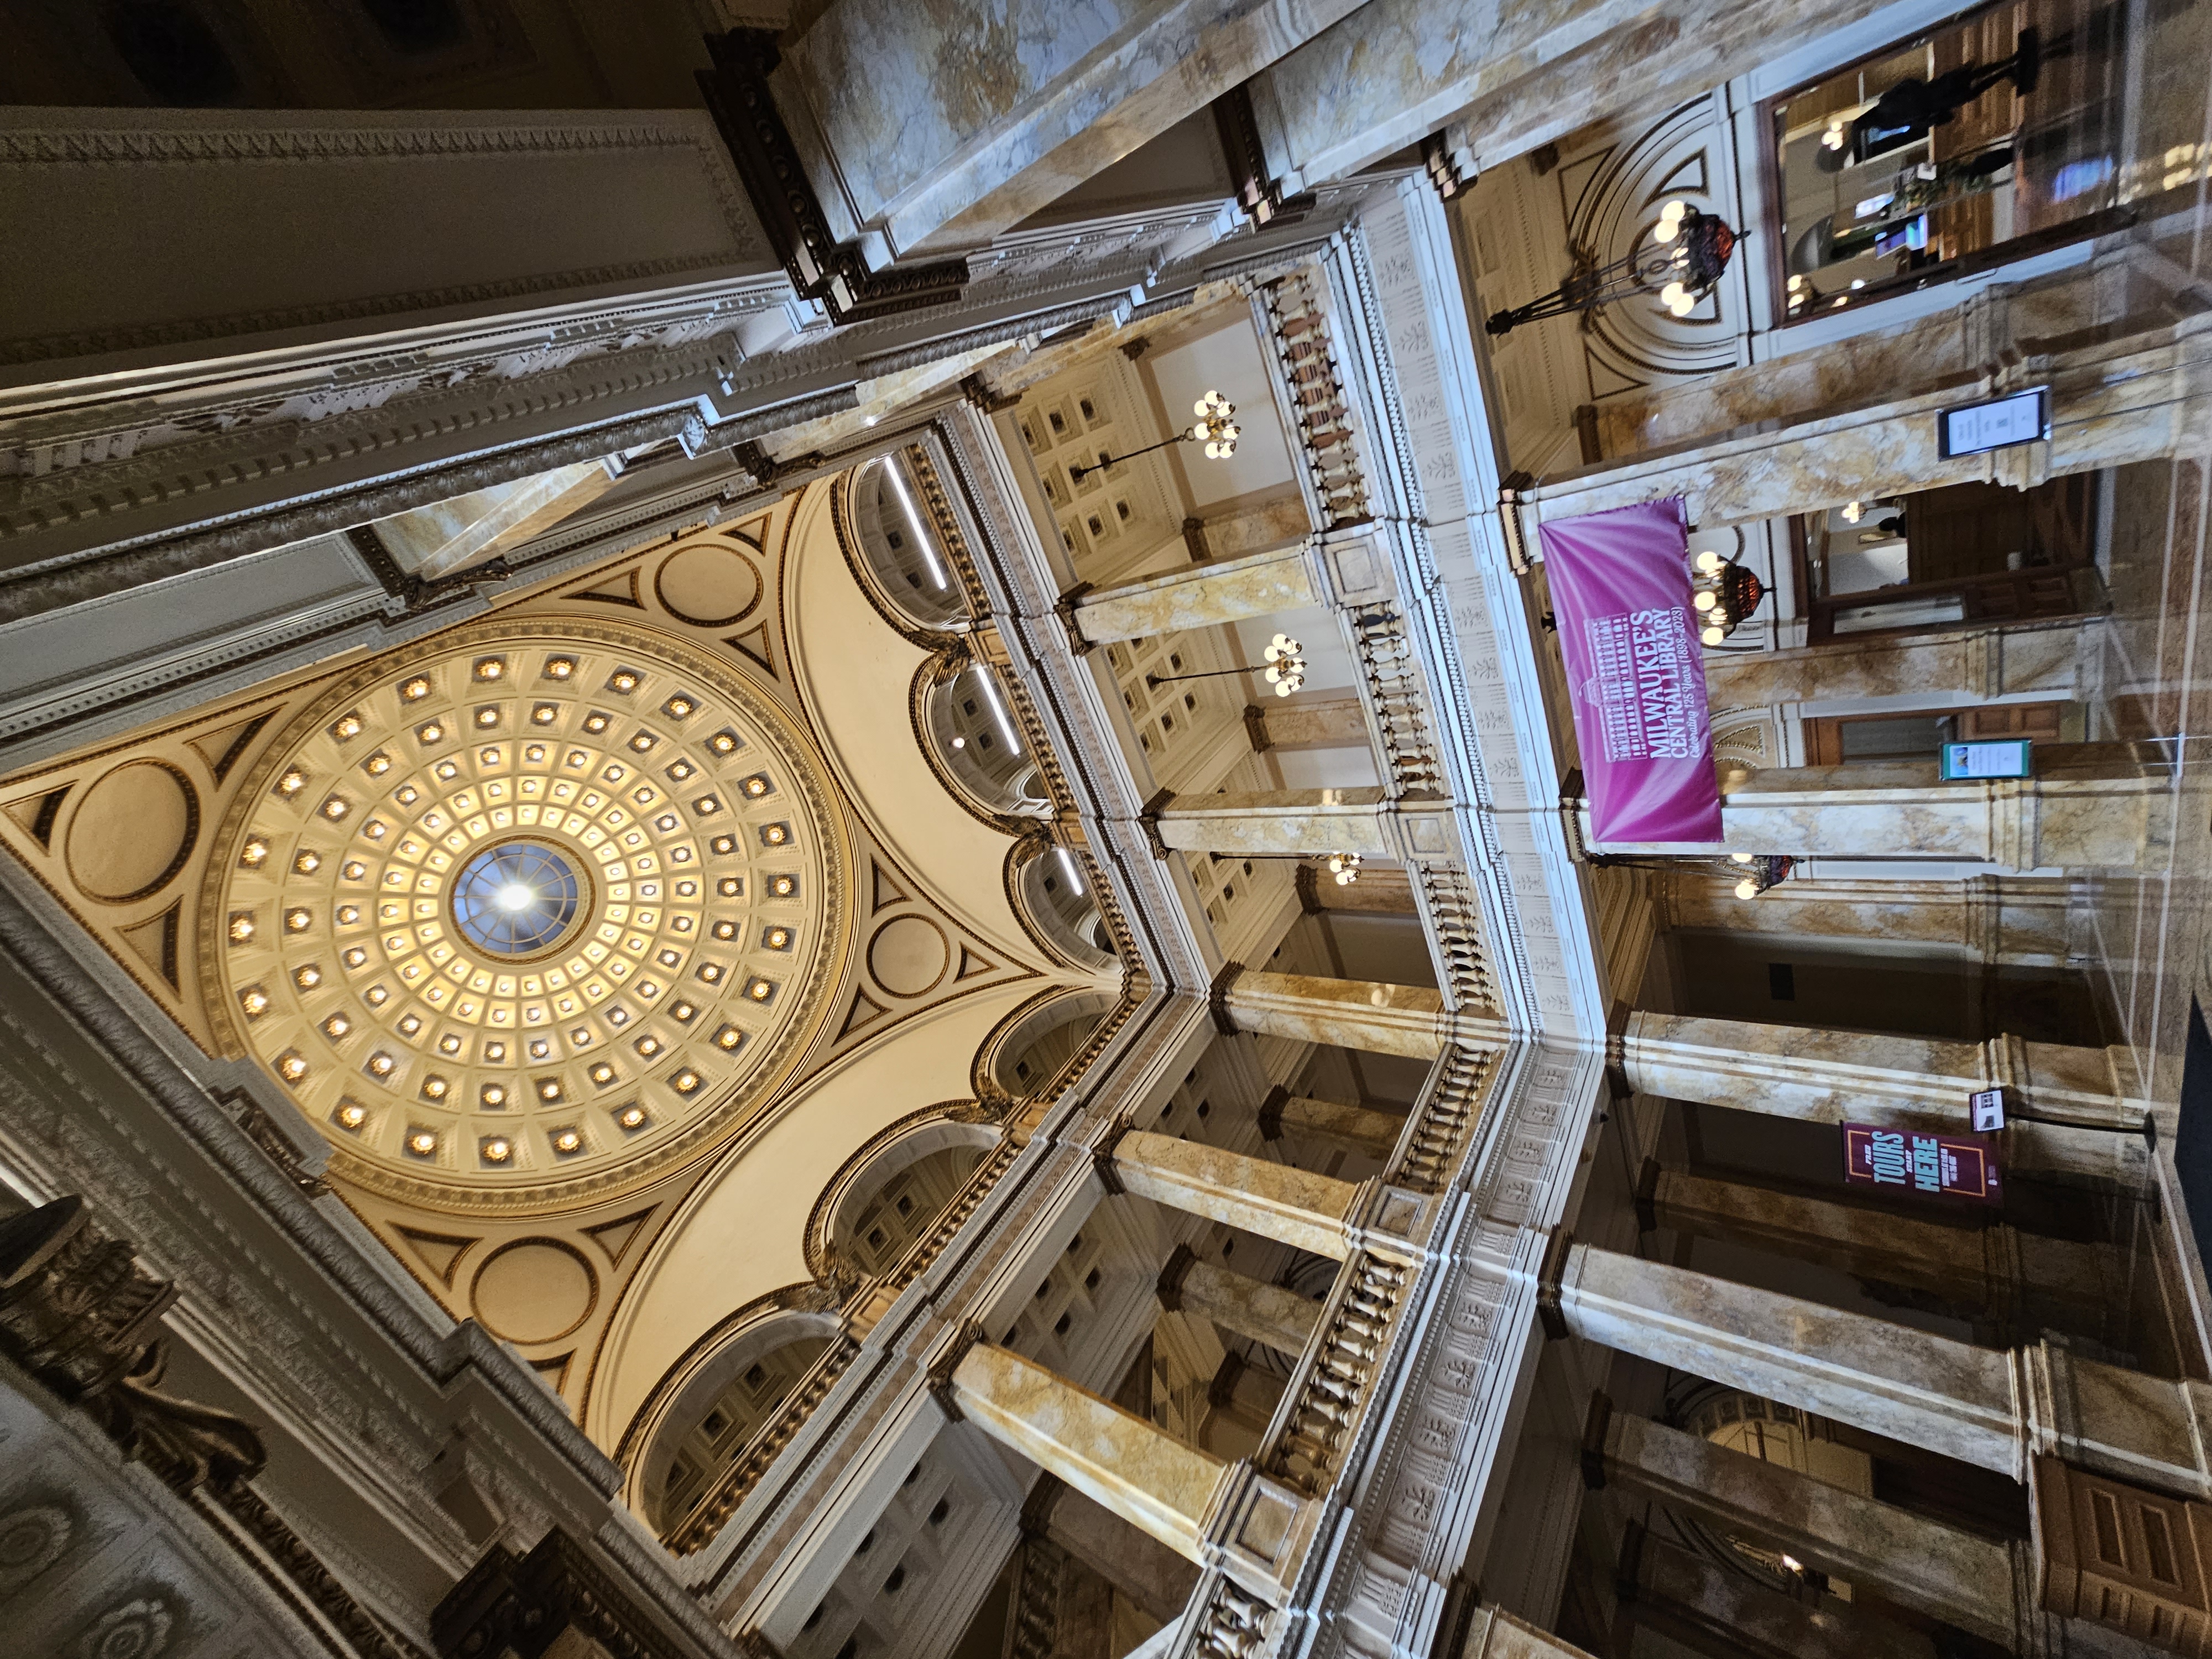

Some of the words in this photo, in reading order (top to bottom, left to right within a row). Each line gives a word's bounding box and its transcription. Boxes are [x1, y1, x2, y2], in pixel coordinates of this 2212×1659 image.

[1652, 608, 1679, 680] LIBRARY
[1630, 610, 1671, 758] MILWAUKEE'S
[1682, 665, 1696, 691] Years
[1684, 691, 1695, 708] 125
[1665, 682, 1688, 759] CENTRAL
[1686, 711, 1700, 758] Celebrating
[1871, 1131, 1906, 1185] TOURS
[1912, 1136, 1940, 1192] HERE
